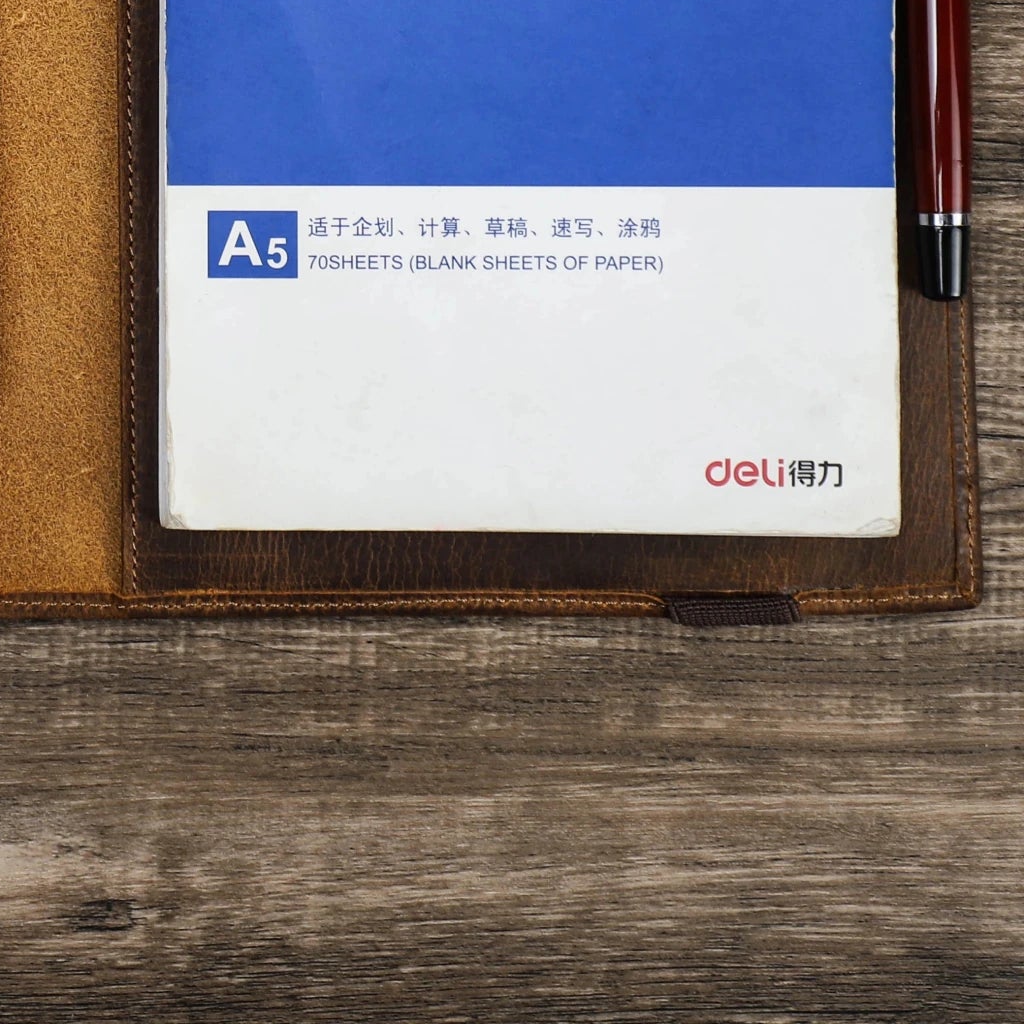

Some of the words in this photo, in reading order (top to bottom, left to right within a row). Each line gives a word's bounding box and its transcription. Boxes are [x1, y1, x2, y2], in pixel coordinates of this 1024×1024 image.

[308, 216, 662, 239] 适于企划、计算、草稿、速写、涂鸦
[218, 220, 288, 269] A5
[308, 255, 403, 272] 70SHEETS
[409, 255, 477, 274] (BLANK
[482, 255, 558, 272] SHEETS
[563, 255, 589, 272] OF
[595, 255, 664, 274] PAPER)
[705, 458, 785, 488] deli
[788, 459, 843, 488] 得力
